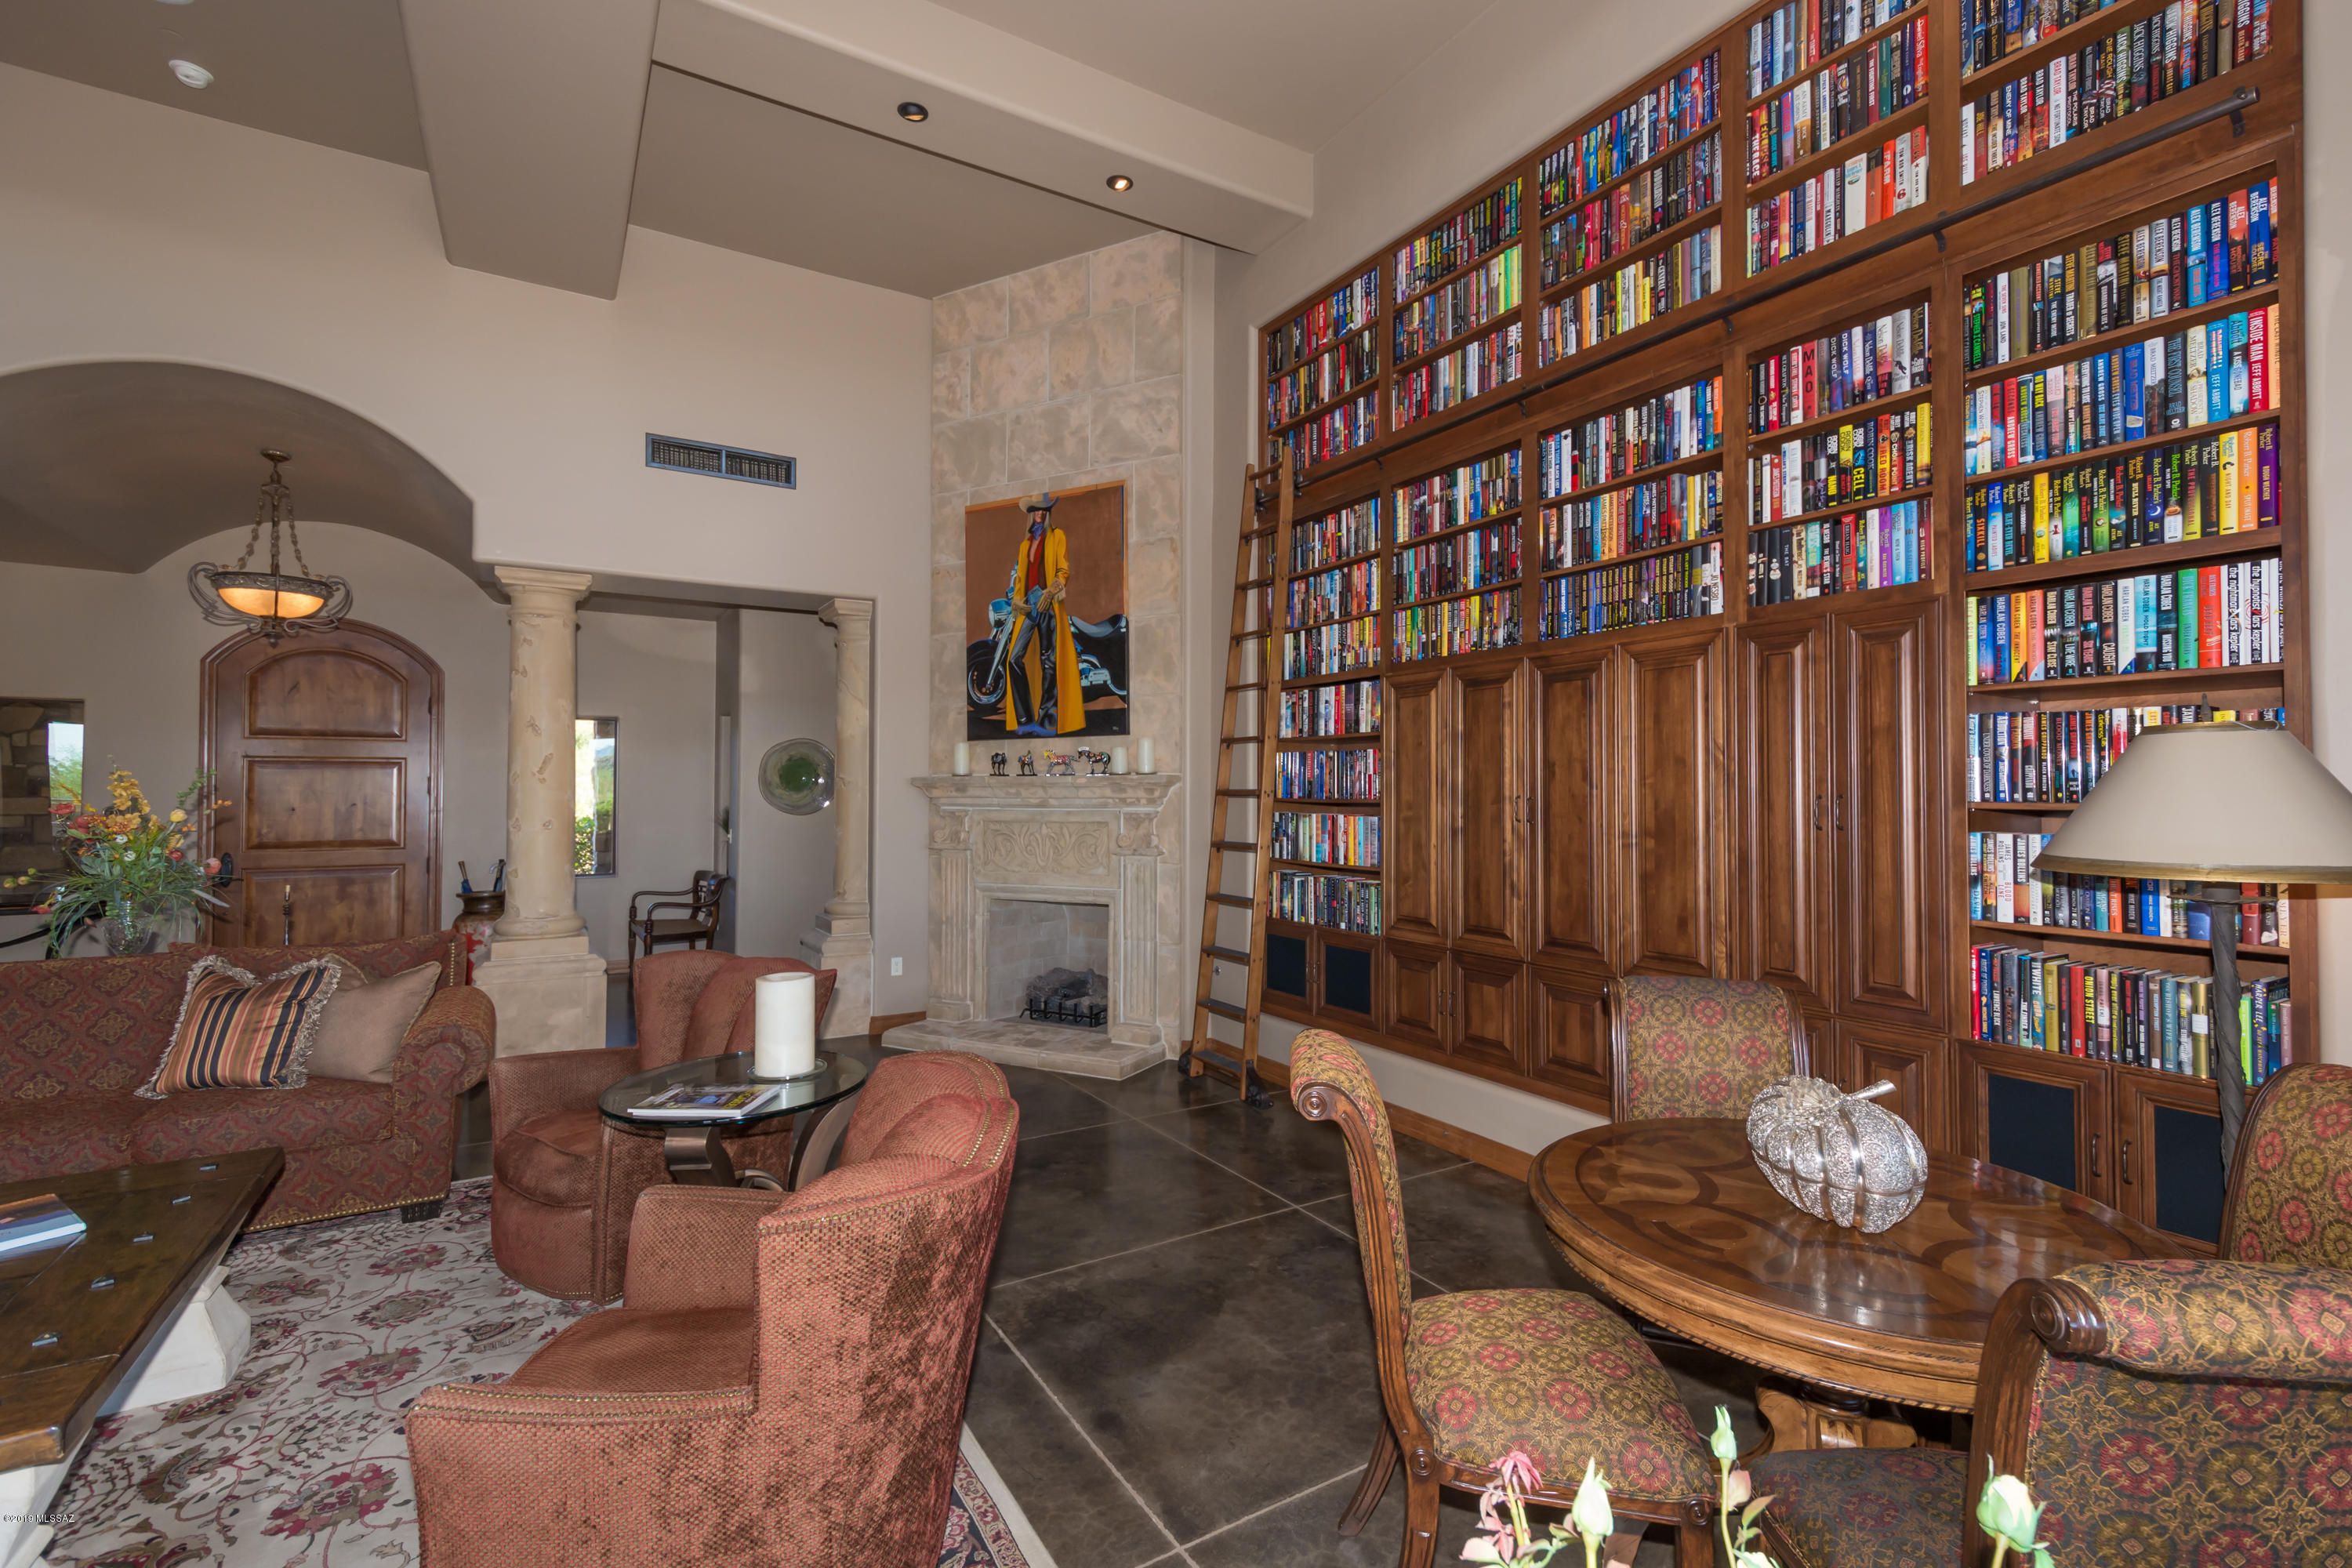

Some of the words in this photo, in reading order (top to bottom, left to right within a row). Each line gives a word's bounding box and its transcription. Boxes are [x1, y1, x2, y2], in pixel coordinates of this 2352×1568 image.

[2165, 8, 2176, 30] JACK
[2134, 21, 2147, 41] JACK
[2118, 33, 2126, 52] JACK
[2151, 31, 2161, 54] HIGGINS
[2165, 31, 2176, 64] HIGGINS
[2133, 42, 2145, 72] HIGGINS
[2117, 53, 2126, 83] HIGGINS
[2250, 191, 2259, 223] BERENSON
[2136, 229, 2145, 241] ALEX
[2154, 223, 2164, 235] ALEX
[2154, 236, 2164, 263] BERENSON
[2065, 253, 2074, 268] STEVE
[2230, 320, 2243, 345] Abbott
[2250, 317, 2263, 343] INSIDE
[2250, 343, 2263, 362] MAN
[2252, 363, 2262, 376] JEFF
[2252, 378, 2261, 399] ABBOTT
[2212, 389, 2220, 409] ABBOTT
[1828, 475, 1837, 495] NANO
[1853, 467, 1864, 492] CELL
[2229, 568, 2238, 579] the
[2102, 585, 2113, 604] HARLAN
[2161, 575, 2172, 594] HARLAN
[2249, 579, 2260, 610] hypnotist
[2064, 590, 2075, 608] HARLAN
[2161, 595, 2172, 610] COBEN
[2227, 580, 2238, 612] nightmare
[1996, 597, 2005, 622] HARLAN
[2064, 608, 2075, 626] COBEN
[2102, 604, 2113, 622] COBEN
[2230, 618, 2239, 630] lars
[2252, 615, 2261, 627] lars
[1997, 623, 2005, 644] COBEN
[2229, 632, 2239, 652] kepler
[2252, 630, 2261, 650] kepler
[2103, 643, 2115, 666] CAUGHT
[2016, 838, 2025, 857] JAMES
[2017, 858, 2026, 882] ROLLINS
[2084, 975, 2094, 997] ONION
[2085, 999, 2095, 1024] STREET
